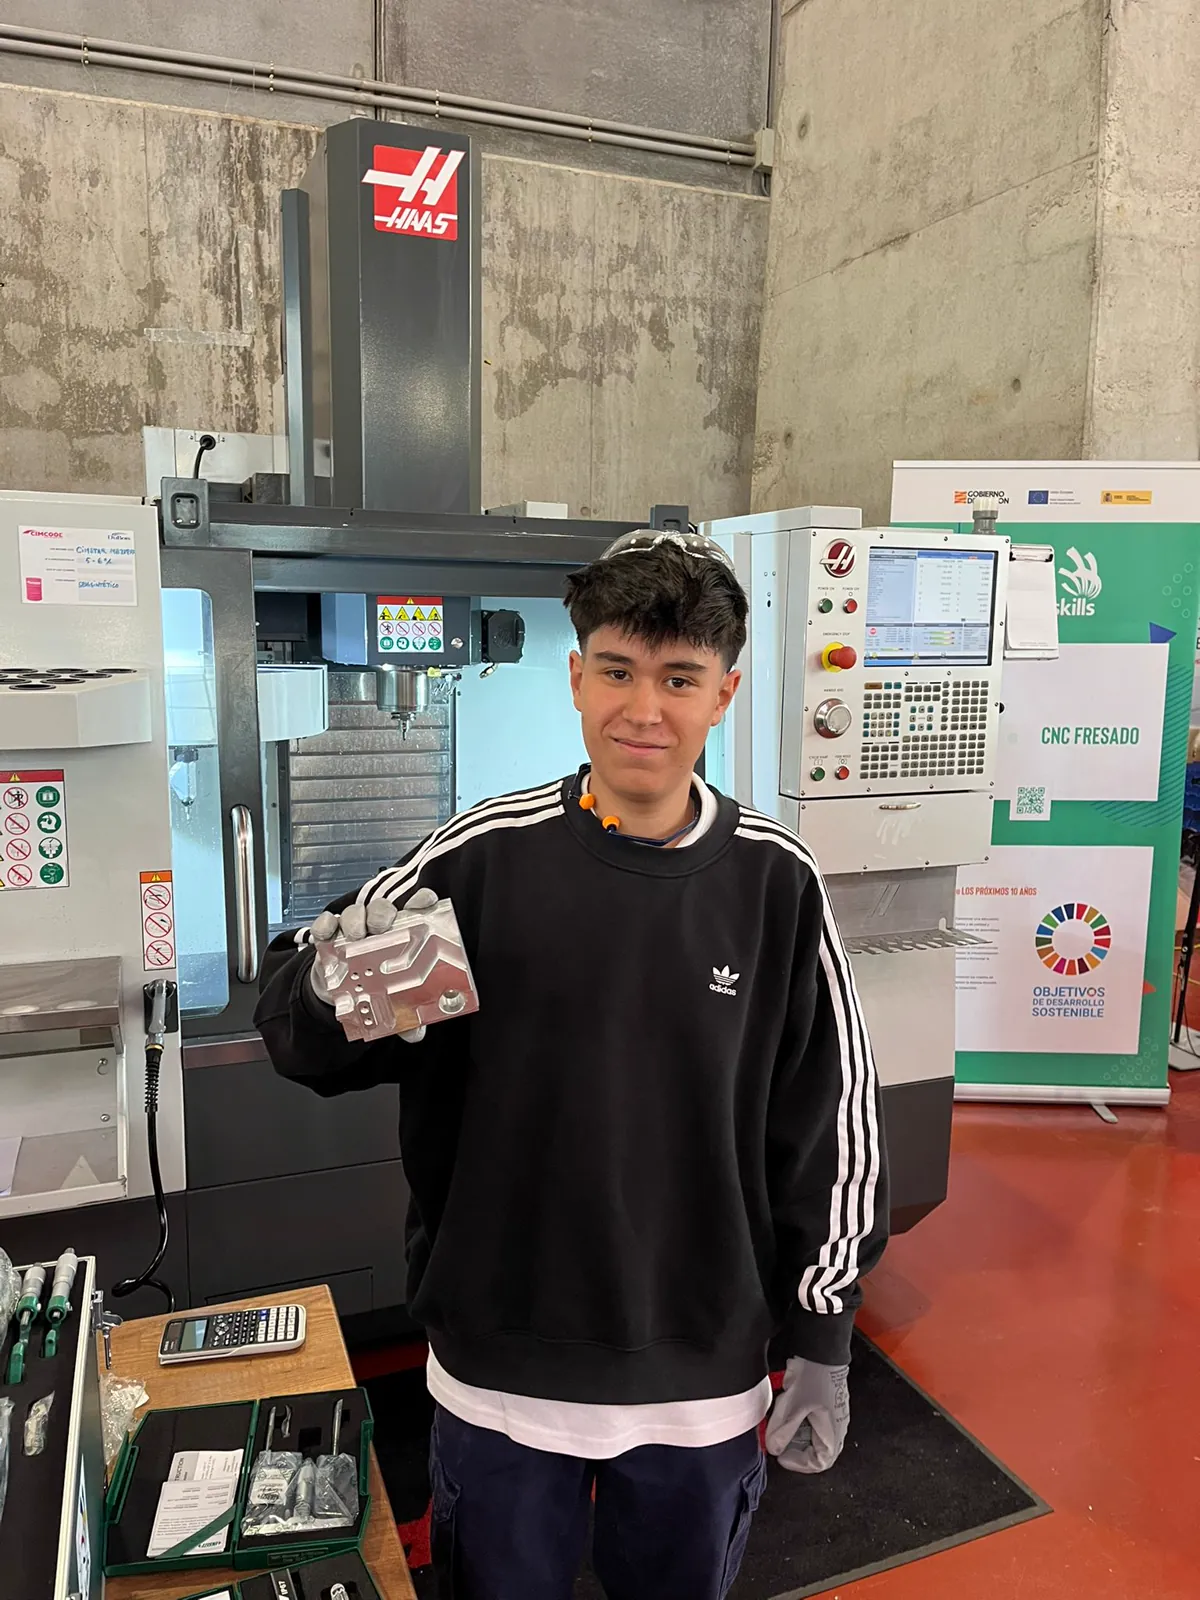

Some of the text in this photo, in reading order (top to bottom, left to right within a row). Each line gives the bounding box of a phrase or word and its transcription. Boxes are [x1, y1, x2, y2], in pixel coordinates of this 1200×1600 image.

[374, 207, 458, 234] HAAS
[1042, 727, 1139, 744] CNC FRESADO
[961, 887, 974, 895] LOS
[975, 885, 1009, 895] PRÓXIMOS
[1010, 887, 1018, 895] 10
[1019, 886, 1037, 895] AÑOS
[709, 983, 737, 996] adidas
[1033, 987, 1105, 997] OBJETIVOS
[1032, 1008, 1104, 1017] SOSTENIBLE
